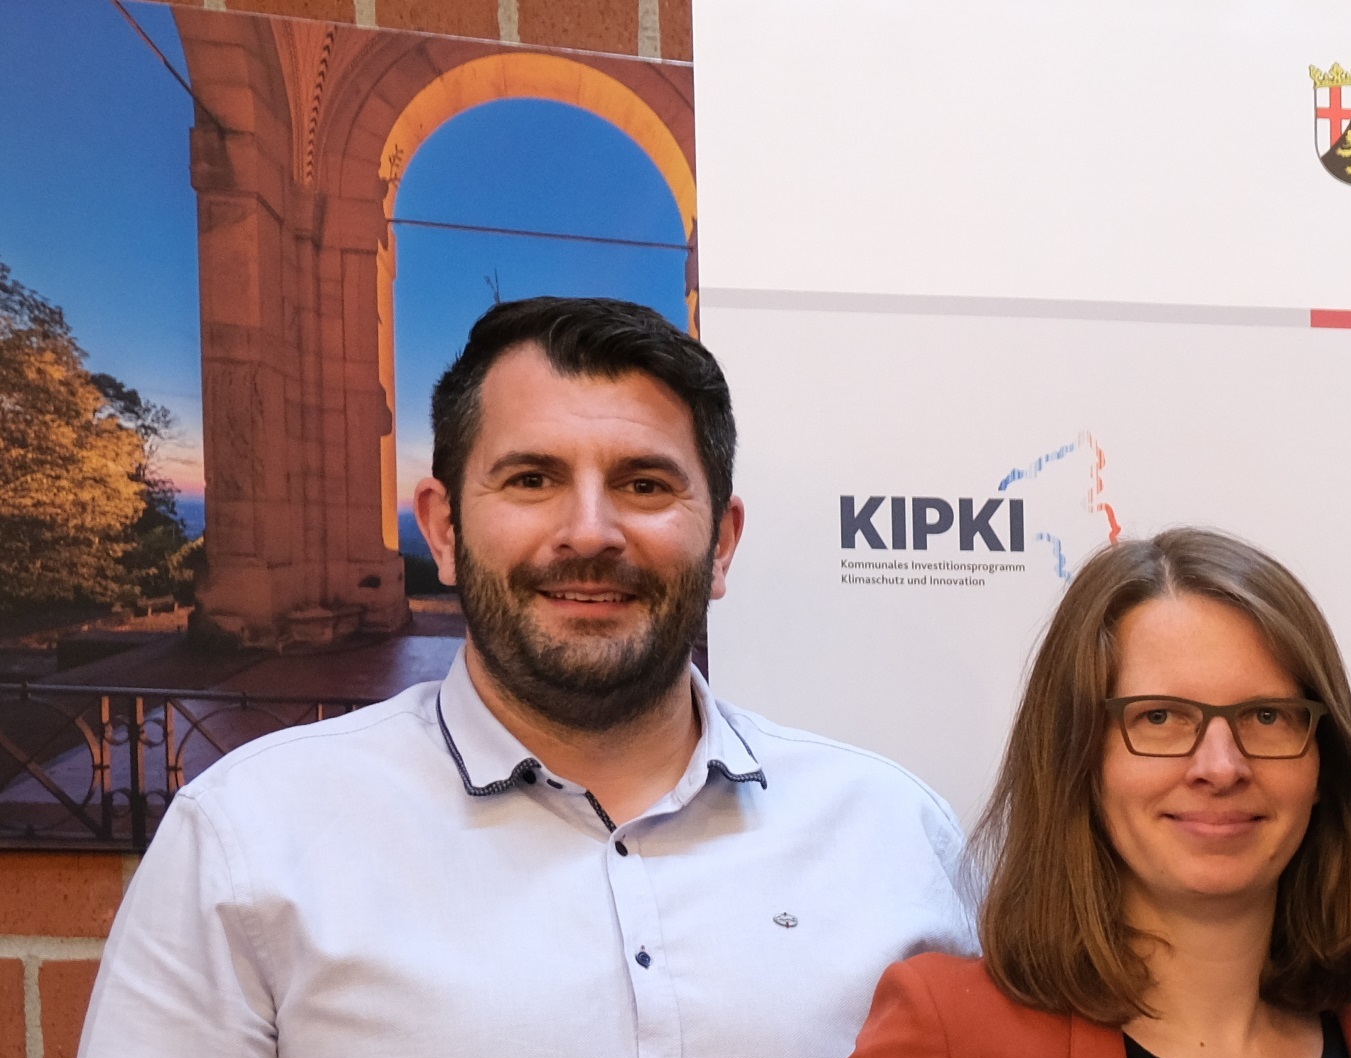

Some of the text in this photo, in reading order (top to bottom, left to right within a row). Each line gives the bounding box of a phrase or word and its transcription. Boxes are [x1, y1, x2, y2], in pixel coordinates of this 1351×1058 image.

[840, 495, 1024, 552] KIPKI
[841, 560, 1025, 574] Kommunales Investitionsprogramm
[841, 575, 985, 586] Klimaschutz und Innovation
